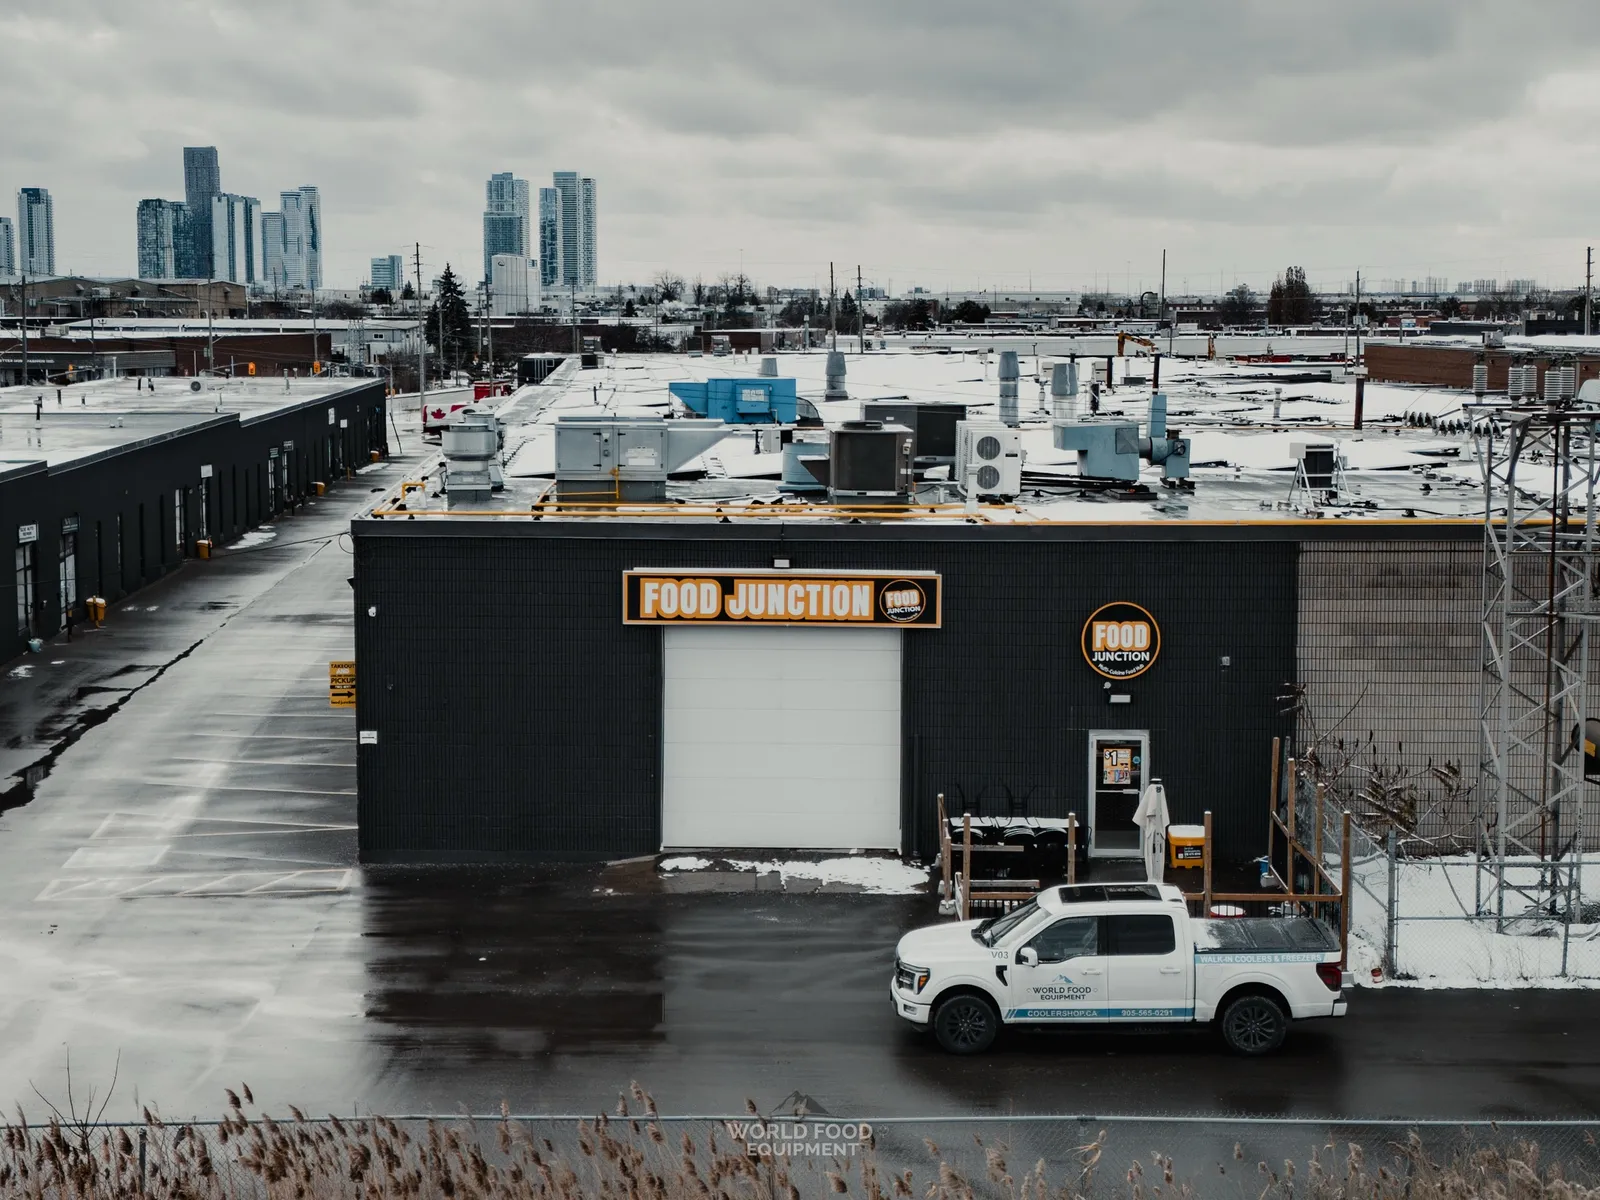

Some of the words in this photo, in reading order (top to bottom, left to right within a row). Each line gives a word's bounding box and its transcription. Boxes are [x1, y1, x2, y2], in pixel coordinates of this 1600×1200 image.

[643, 581, 718, 615] FOOD
[728, 582, 871, 618] JUNCTION
[887, 590, 919, 608] FOOD
[887, 606, 921, 615] JUNCTION
[1095, 624, 1148, 649] FOOD
[1092, 651, 1150, 662] JUNCTION
[991, 951, 1009, 959] V03
[1200, 955, 1233, 963] WALK-IN
[1235, 955, 1272, 963] COOLERS
[1281, 954, 1322, 962] FREEZERS
[1033, 986, 1065, 994] WORLD
[1067, 986, 1092, 994] FOOD
